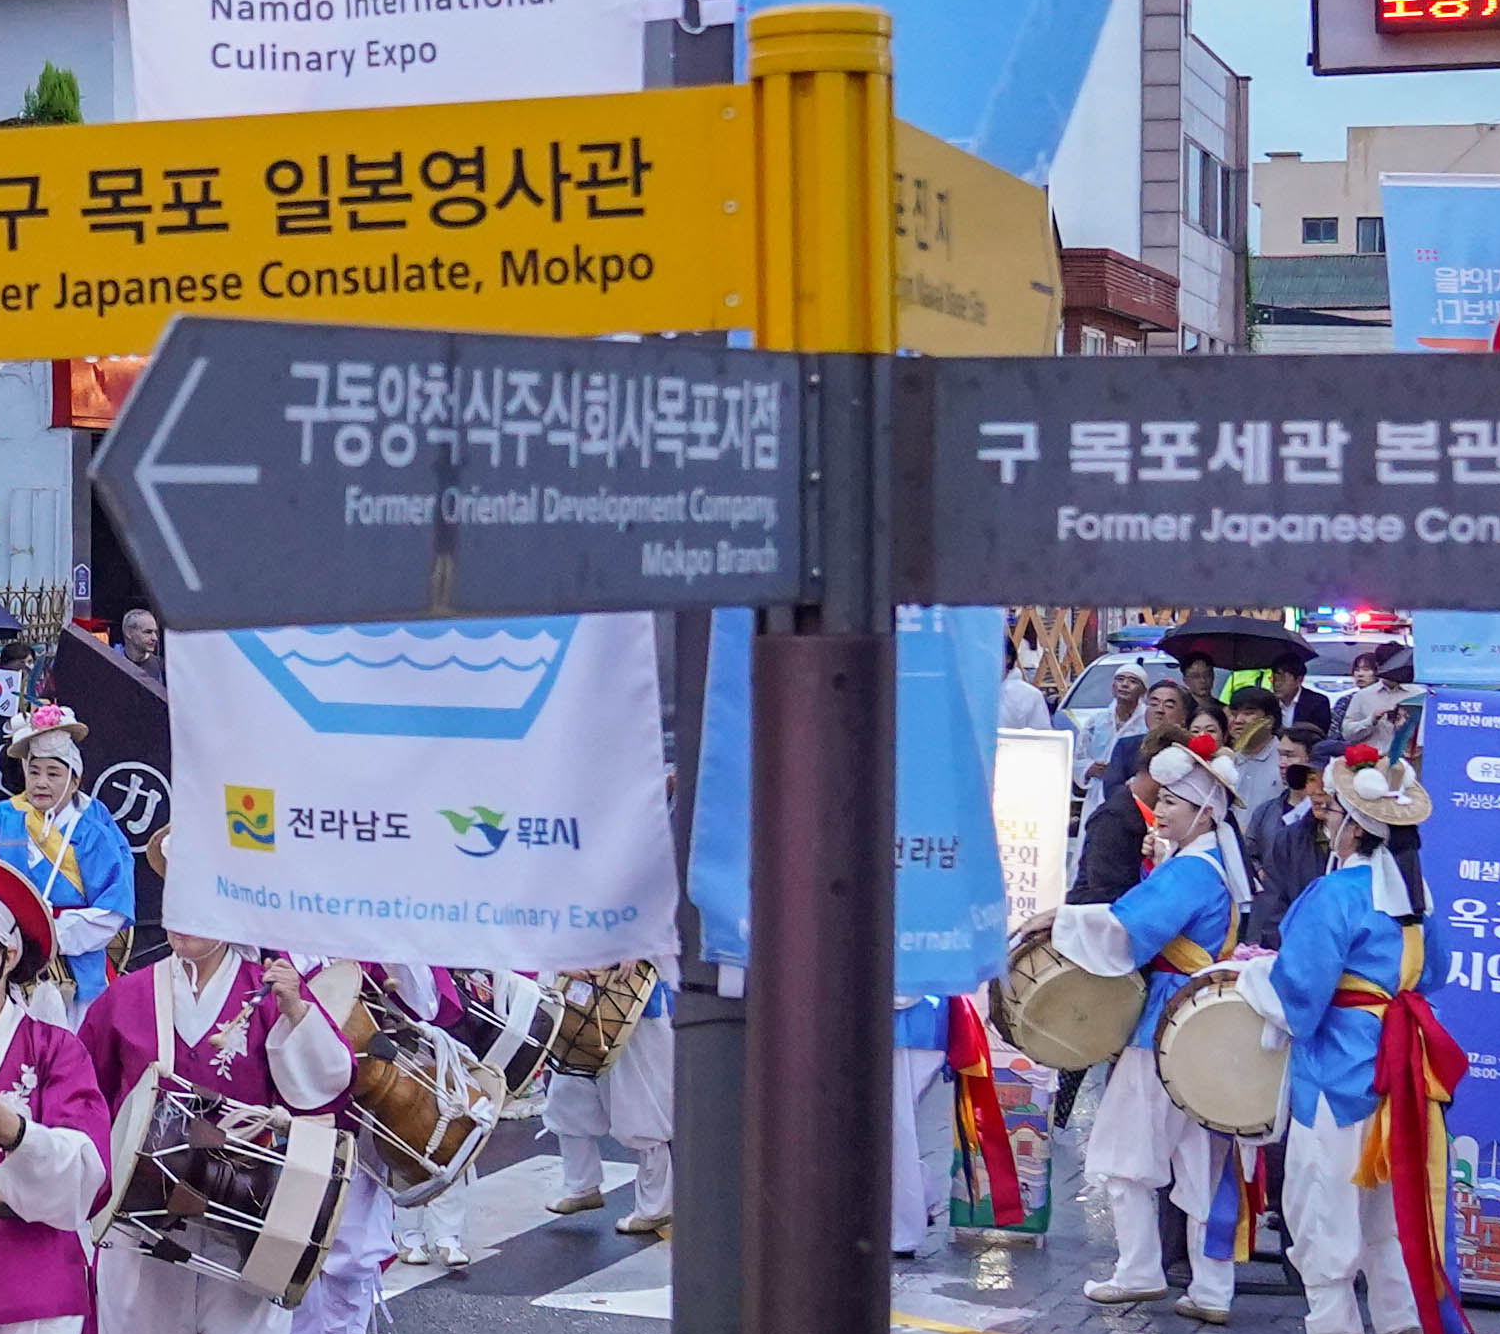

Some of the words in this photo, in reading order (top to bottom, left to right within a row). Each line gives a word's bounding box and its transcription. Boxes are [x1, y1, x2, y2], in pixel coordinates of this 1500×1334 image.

[211, 43, 355, 77] Culinary
[366, 39, 437, 72] Expo
[80, 166, 230, 245] 목포
[264, 136, 654, 236] 일본영사관
[53, 269, 243, 316] Japanese
[259, 253, 484, 299] Consulate,
[500, 244, 656, 290] Mokpo
[977, 421, 1041, 485] 구
[1067, 419, 1349, 485] 목포세관
[345, 484, 436, 525] Former
[441, 485, 538, 525] Oriental
[543, 486, 686, 531] Development
[1056, 506, 1192, 544] Former
[1199, 507, 1404, 548] Japanese
[642, 541, 712, 584] Mokpo
[716, 539, 778, 575] Branch
[1460, 701, 1482, 712] 목포
[288, 807, 412, 843] 전라남도
[517, 816, 580, 850] 목포시
[217, 875, 282, 910] Namdo
[289, 884, 468, 923] International
[476, 901, 560, 932] Culinary
[569, 902, 638, 932] Expo
